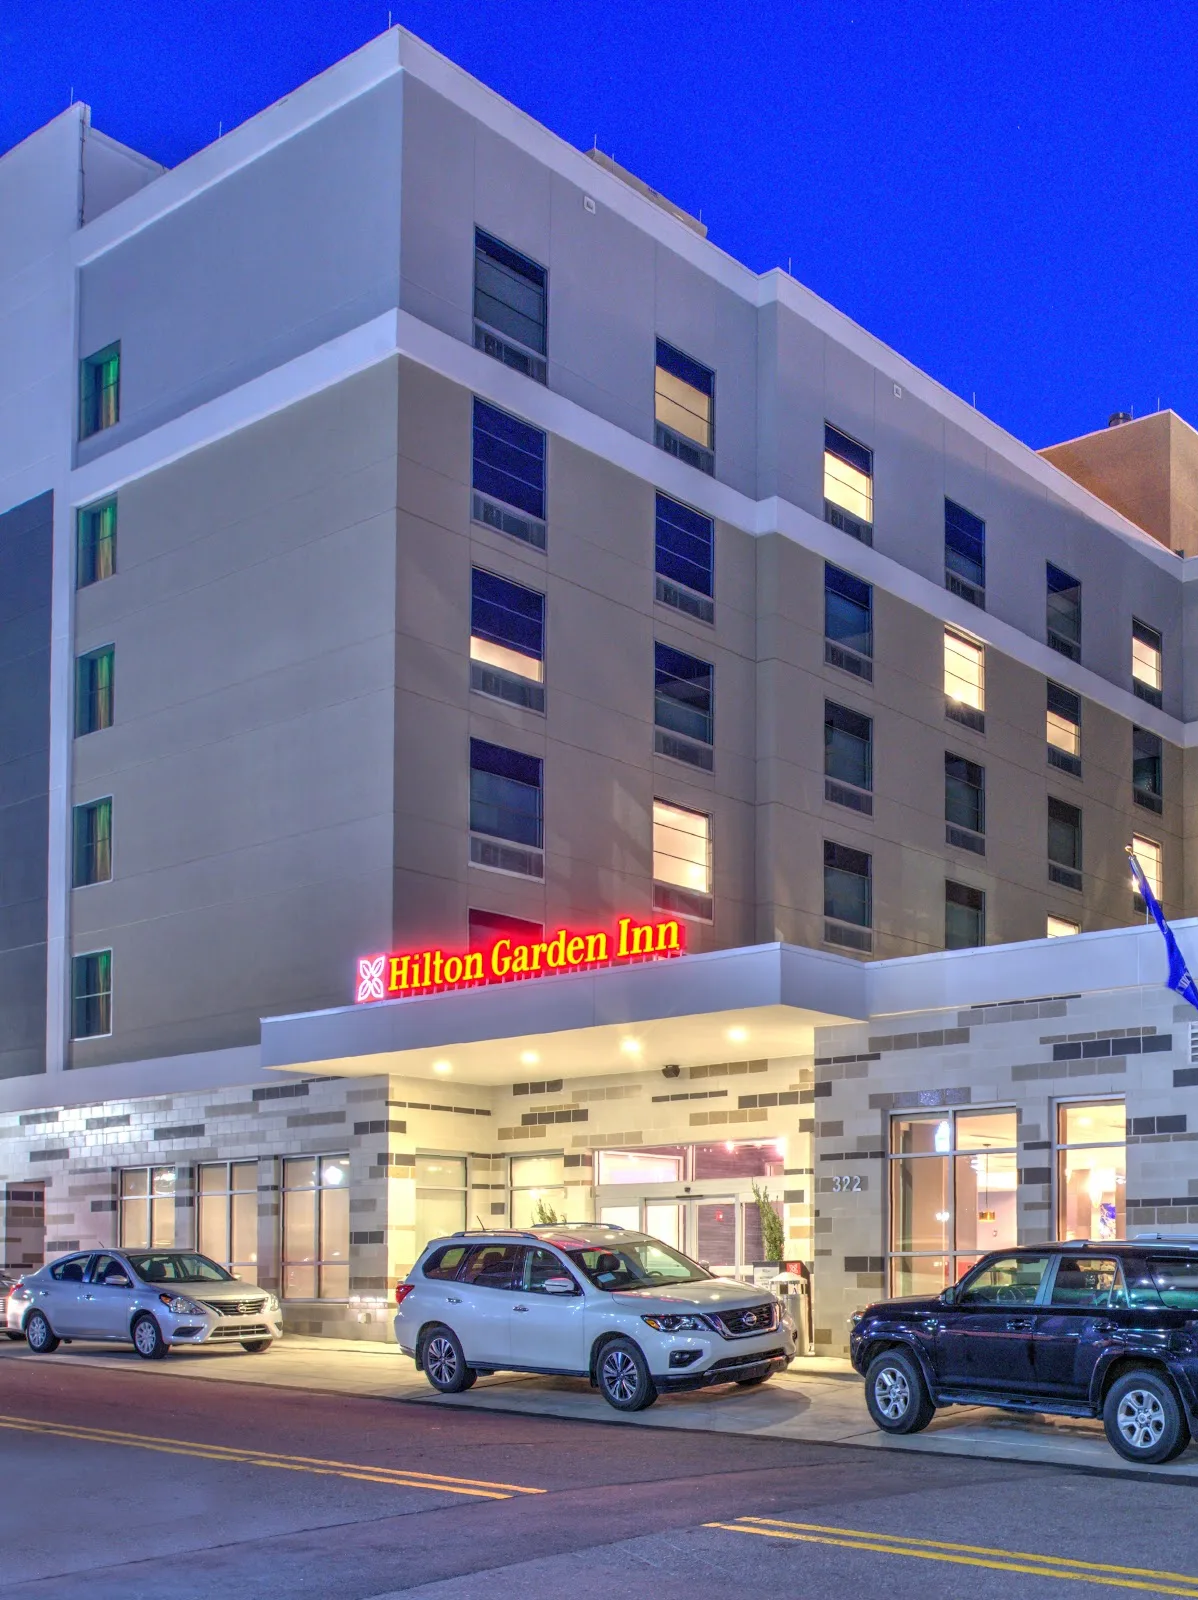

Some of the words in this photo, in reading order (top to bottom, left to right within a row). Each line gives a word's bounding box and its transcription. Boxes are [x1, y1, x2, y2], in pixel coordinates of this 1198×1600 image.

[388, 950, 485, 991] Hilton
[491, 930, 607, 976] Garden
[617, 918, 680, 957] Inn
[832, 1175, 862, 1192] 322
